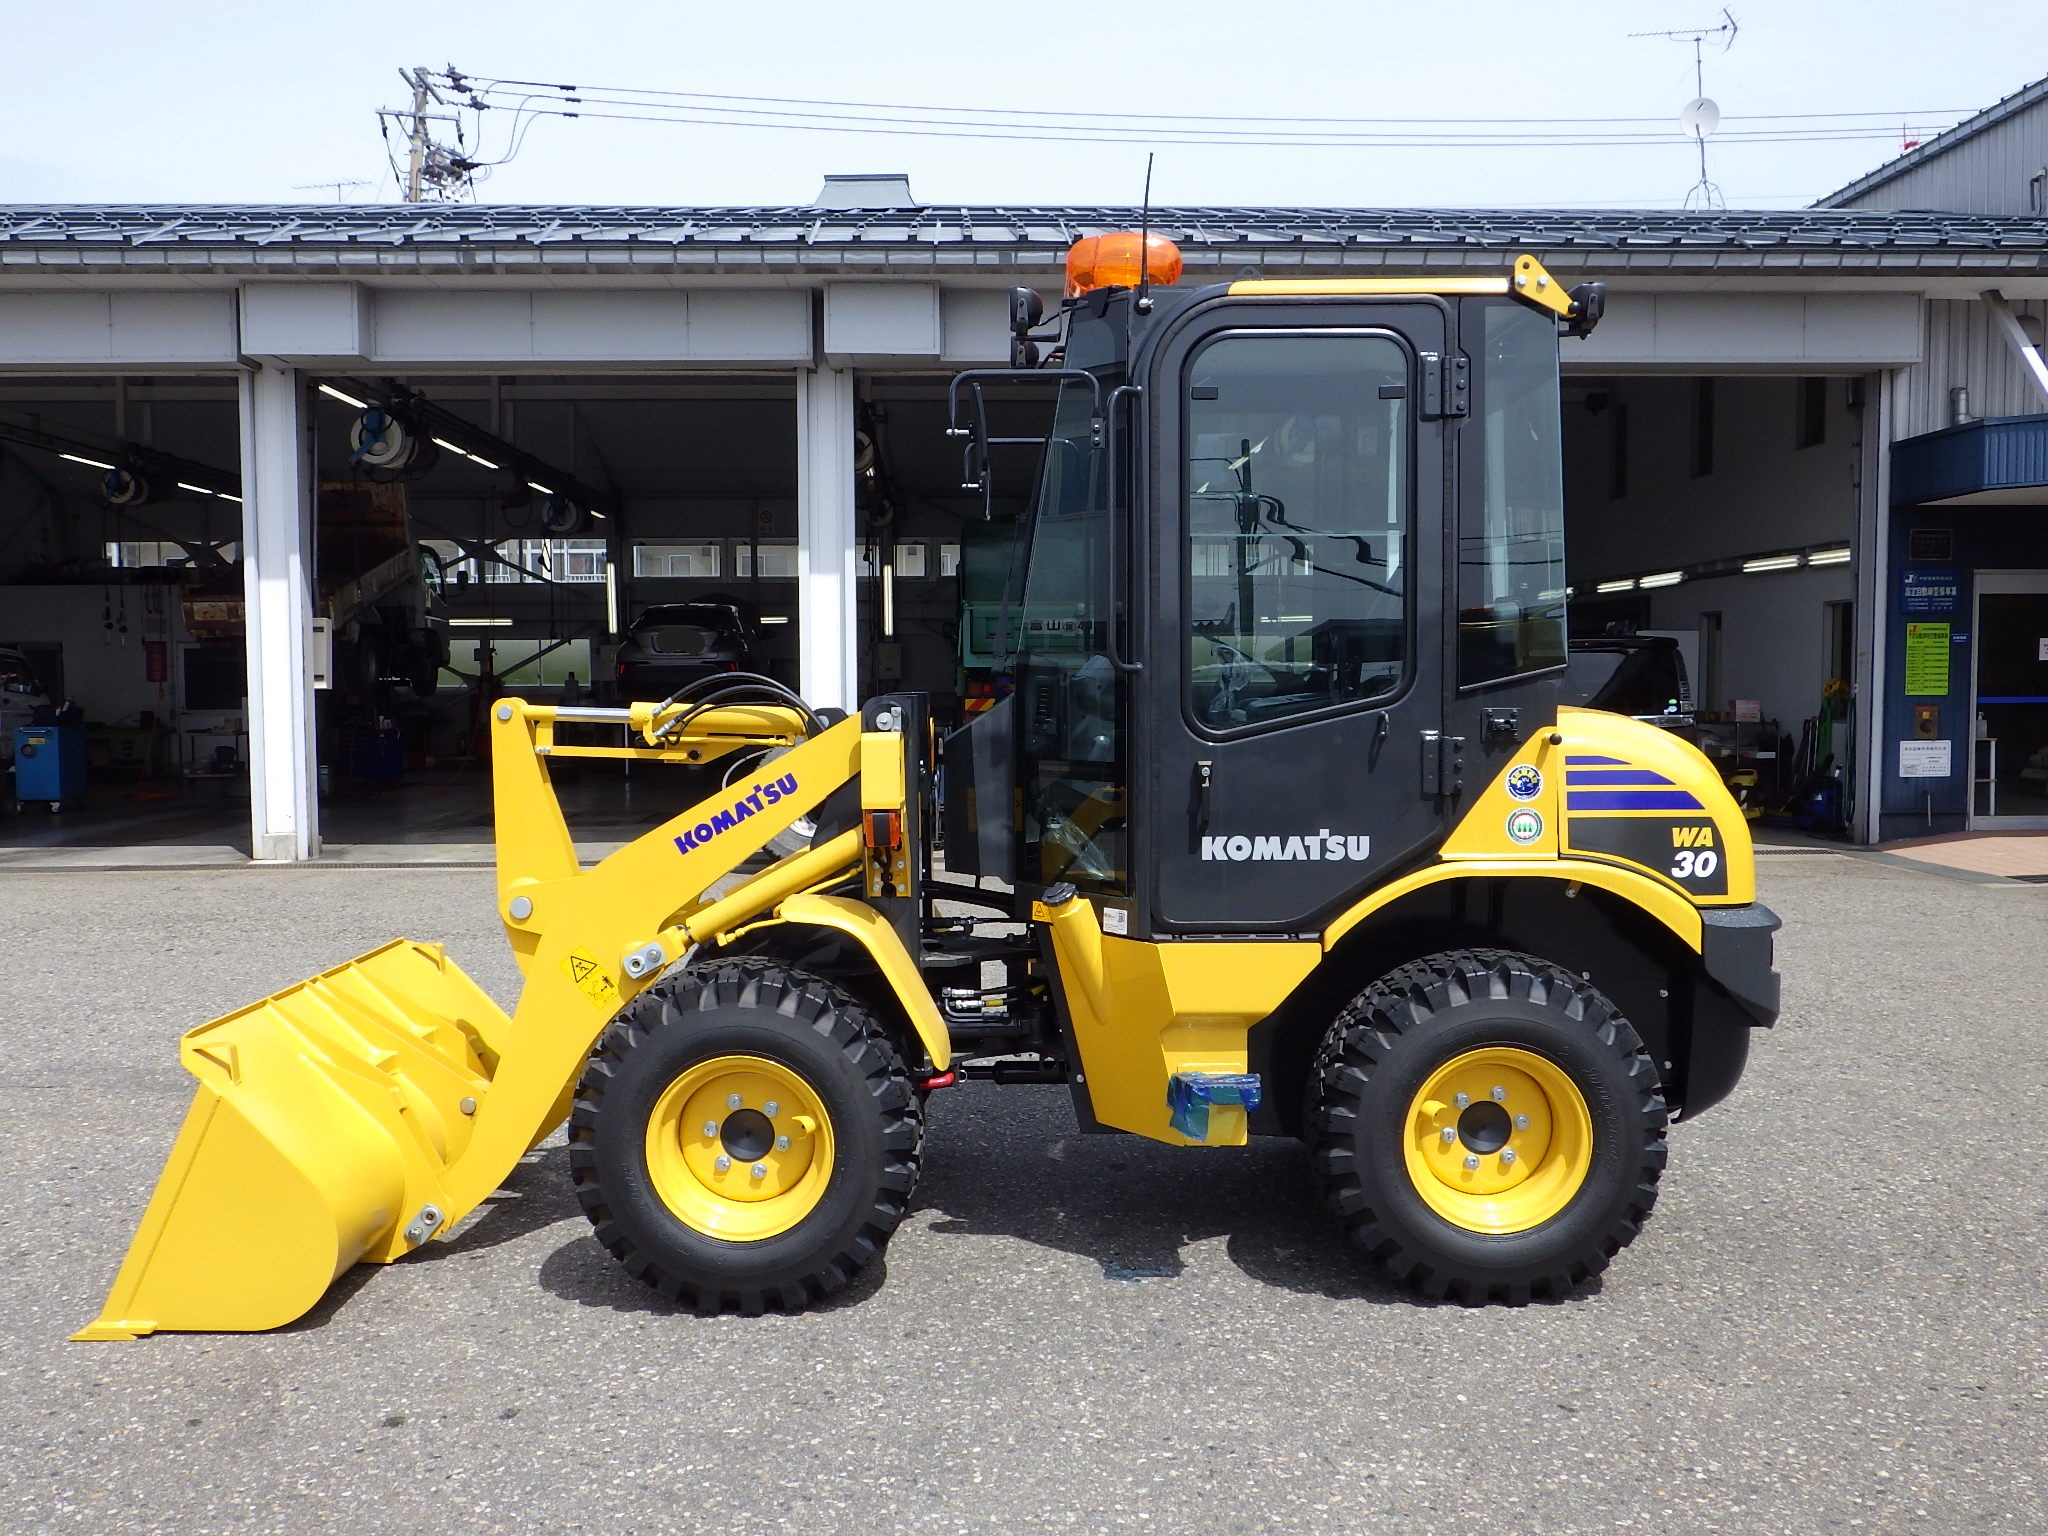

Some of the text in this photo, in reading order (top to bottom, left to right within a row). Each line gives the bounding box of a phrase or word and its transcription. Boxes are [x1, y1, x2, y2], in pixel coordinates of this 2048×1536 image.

[673, 772, 798, 856] KOMATSU
[1201, 828, 1370, 861] KOMATSU
[1671, 827, 1714, 848] WA
[1671, 850, 1718, 878] 30
